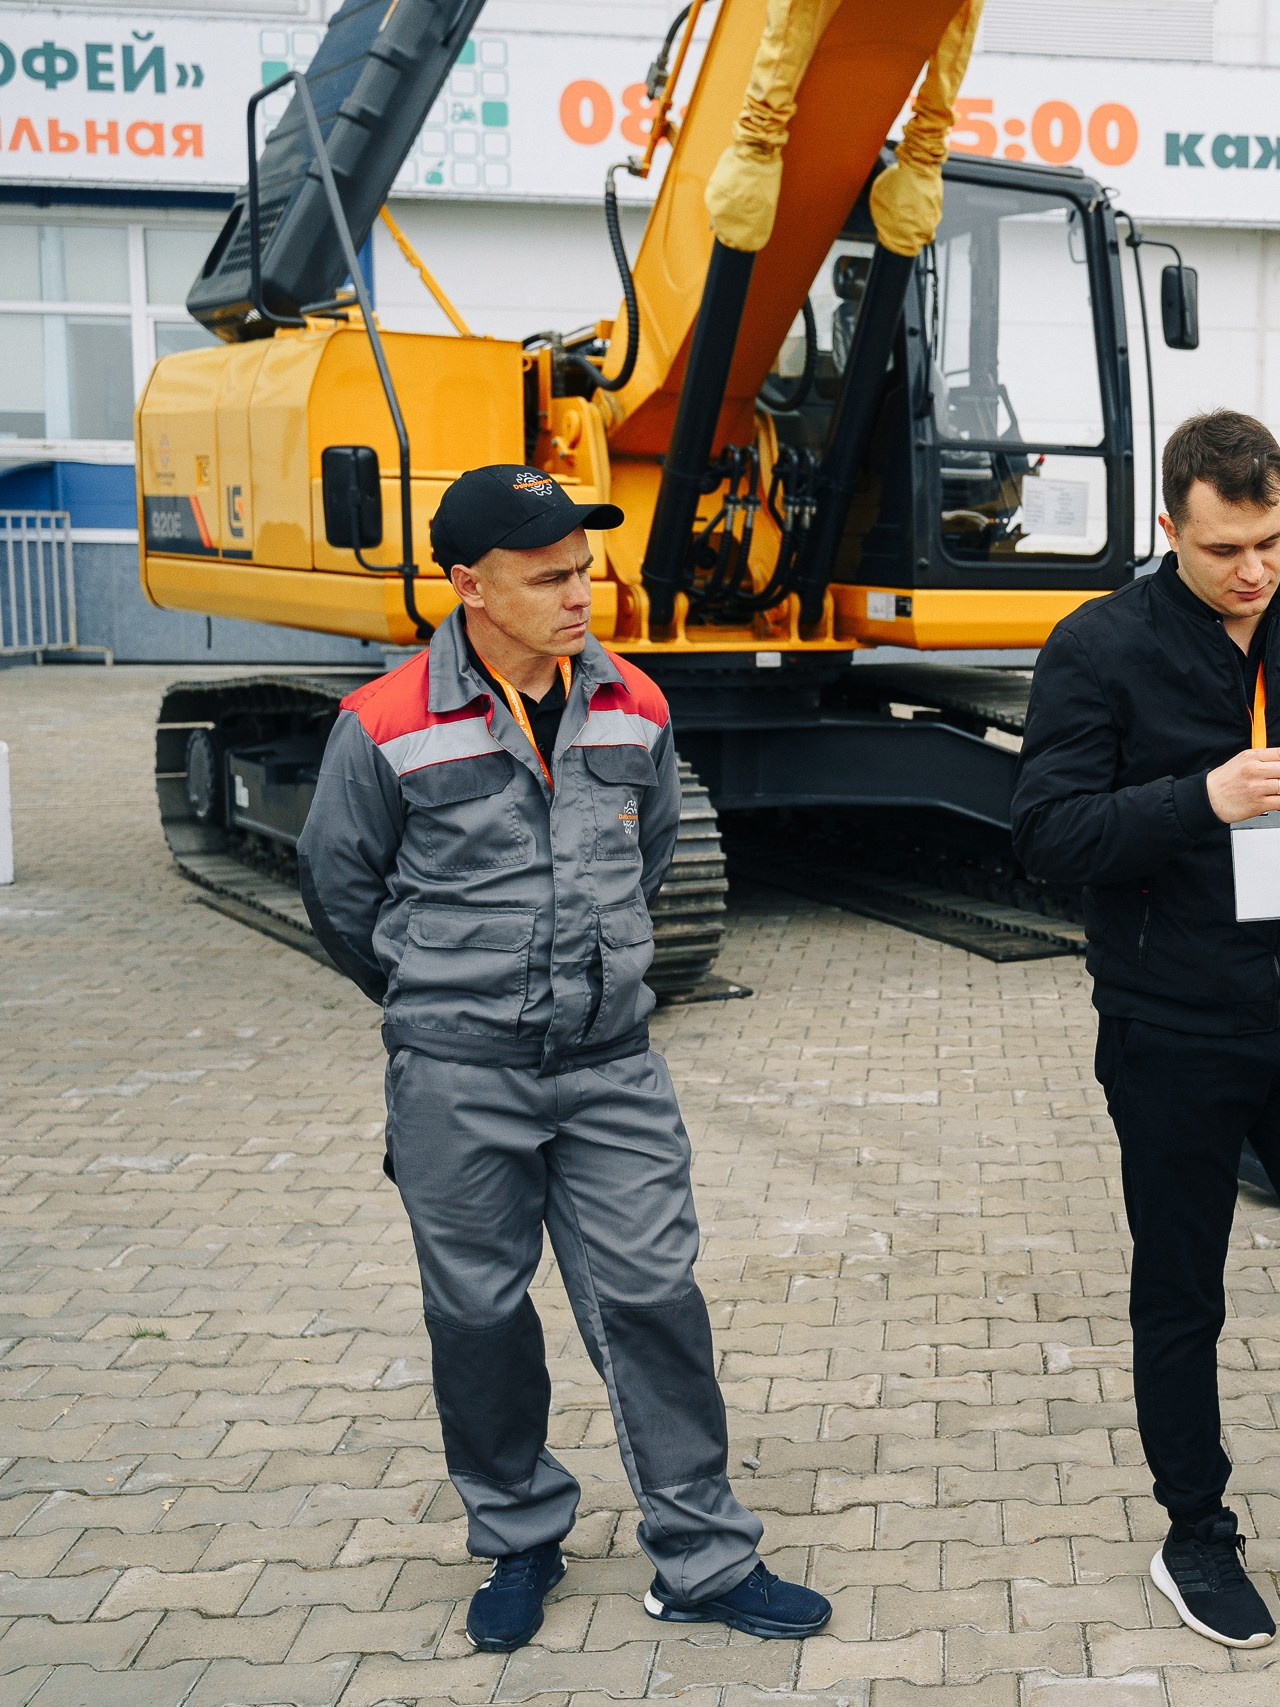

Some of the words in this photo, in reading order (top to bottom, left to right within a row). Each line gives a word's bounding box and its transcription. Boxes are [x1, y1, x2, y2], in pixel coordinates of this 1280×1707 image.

[0, 117, 204, 158] льная
[559, 79, 687, 147] 08
[906, 97, 1139, 166] 5:00
